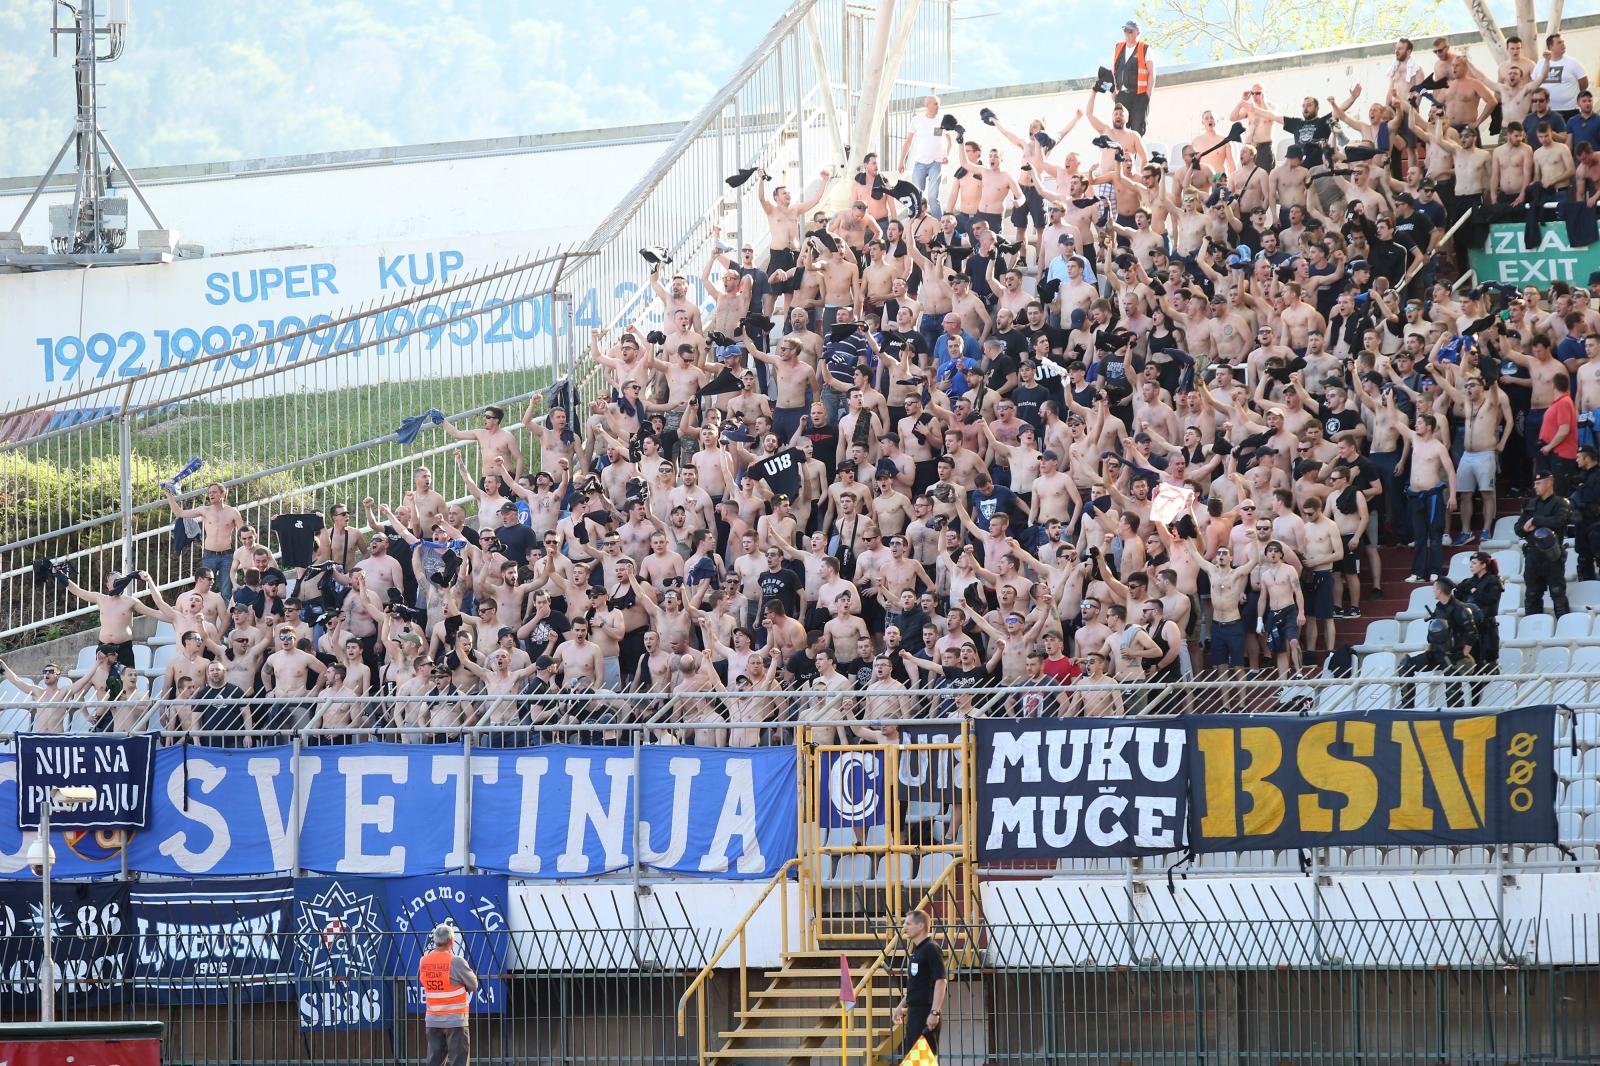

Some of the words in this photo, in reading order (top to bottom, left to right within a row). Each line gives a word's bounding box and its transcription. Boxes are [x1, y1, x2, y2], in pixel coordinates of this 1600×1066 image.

[204, 262, 339, 306] SUPER
[378, 250, 464, 290] KUP
[1498, 258, 1578, 282] EXIT
[36, 331, 147, 383] 1992
[154, 323, 259, 373] 1993
[259, 312, 362, 365] 1994
[365, 300, 478, 356] 1995
[764, 453, 792, 476] U18
[36, 745, 87, 779] NIJE
[95, 745, 130, 773] NA
[986, 726, 1187, 784] MUKU
[1197, 715, 1497, 838] BSN
[159, 756, 767, 873] SVETINJA
[986, 787, 1177, 850] MUČE
[396, 885, 466, 932] dinamo
[470, 896, 504, 934] ZG
[300, 988, 381, 1028] SB86
